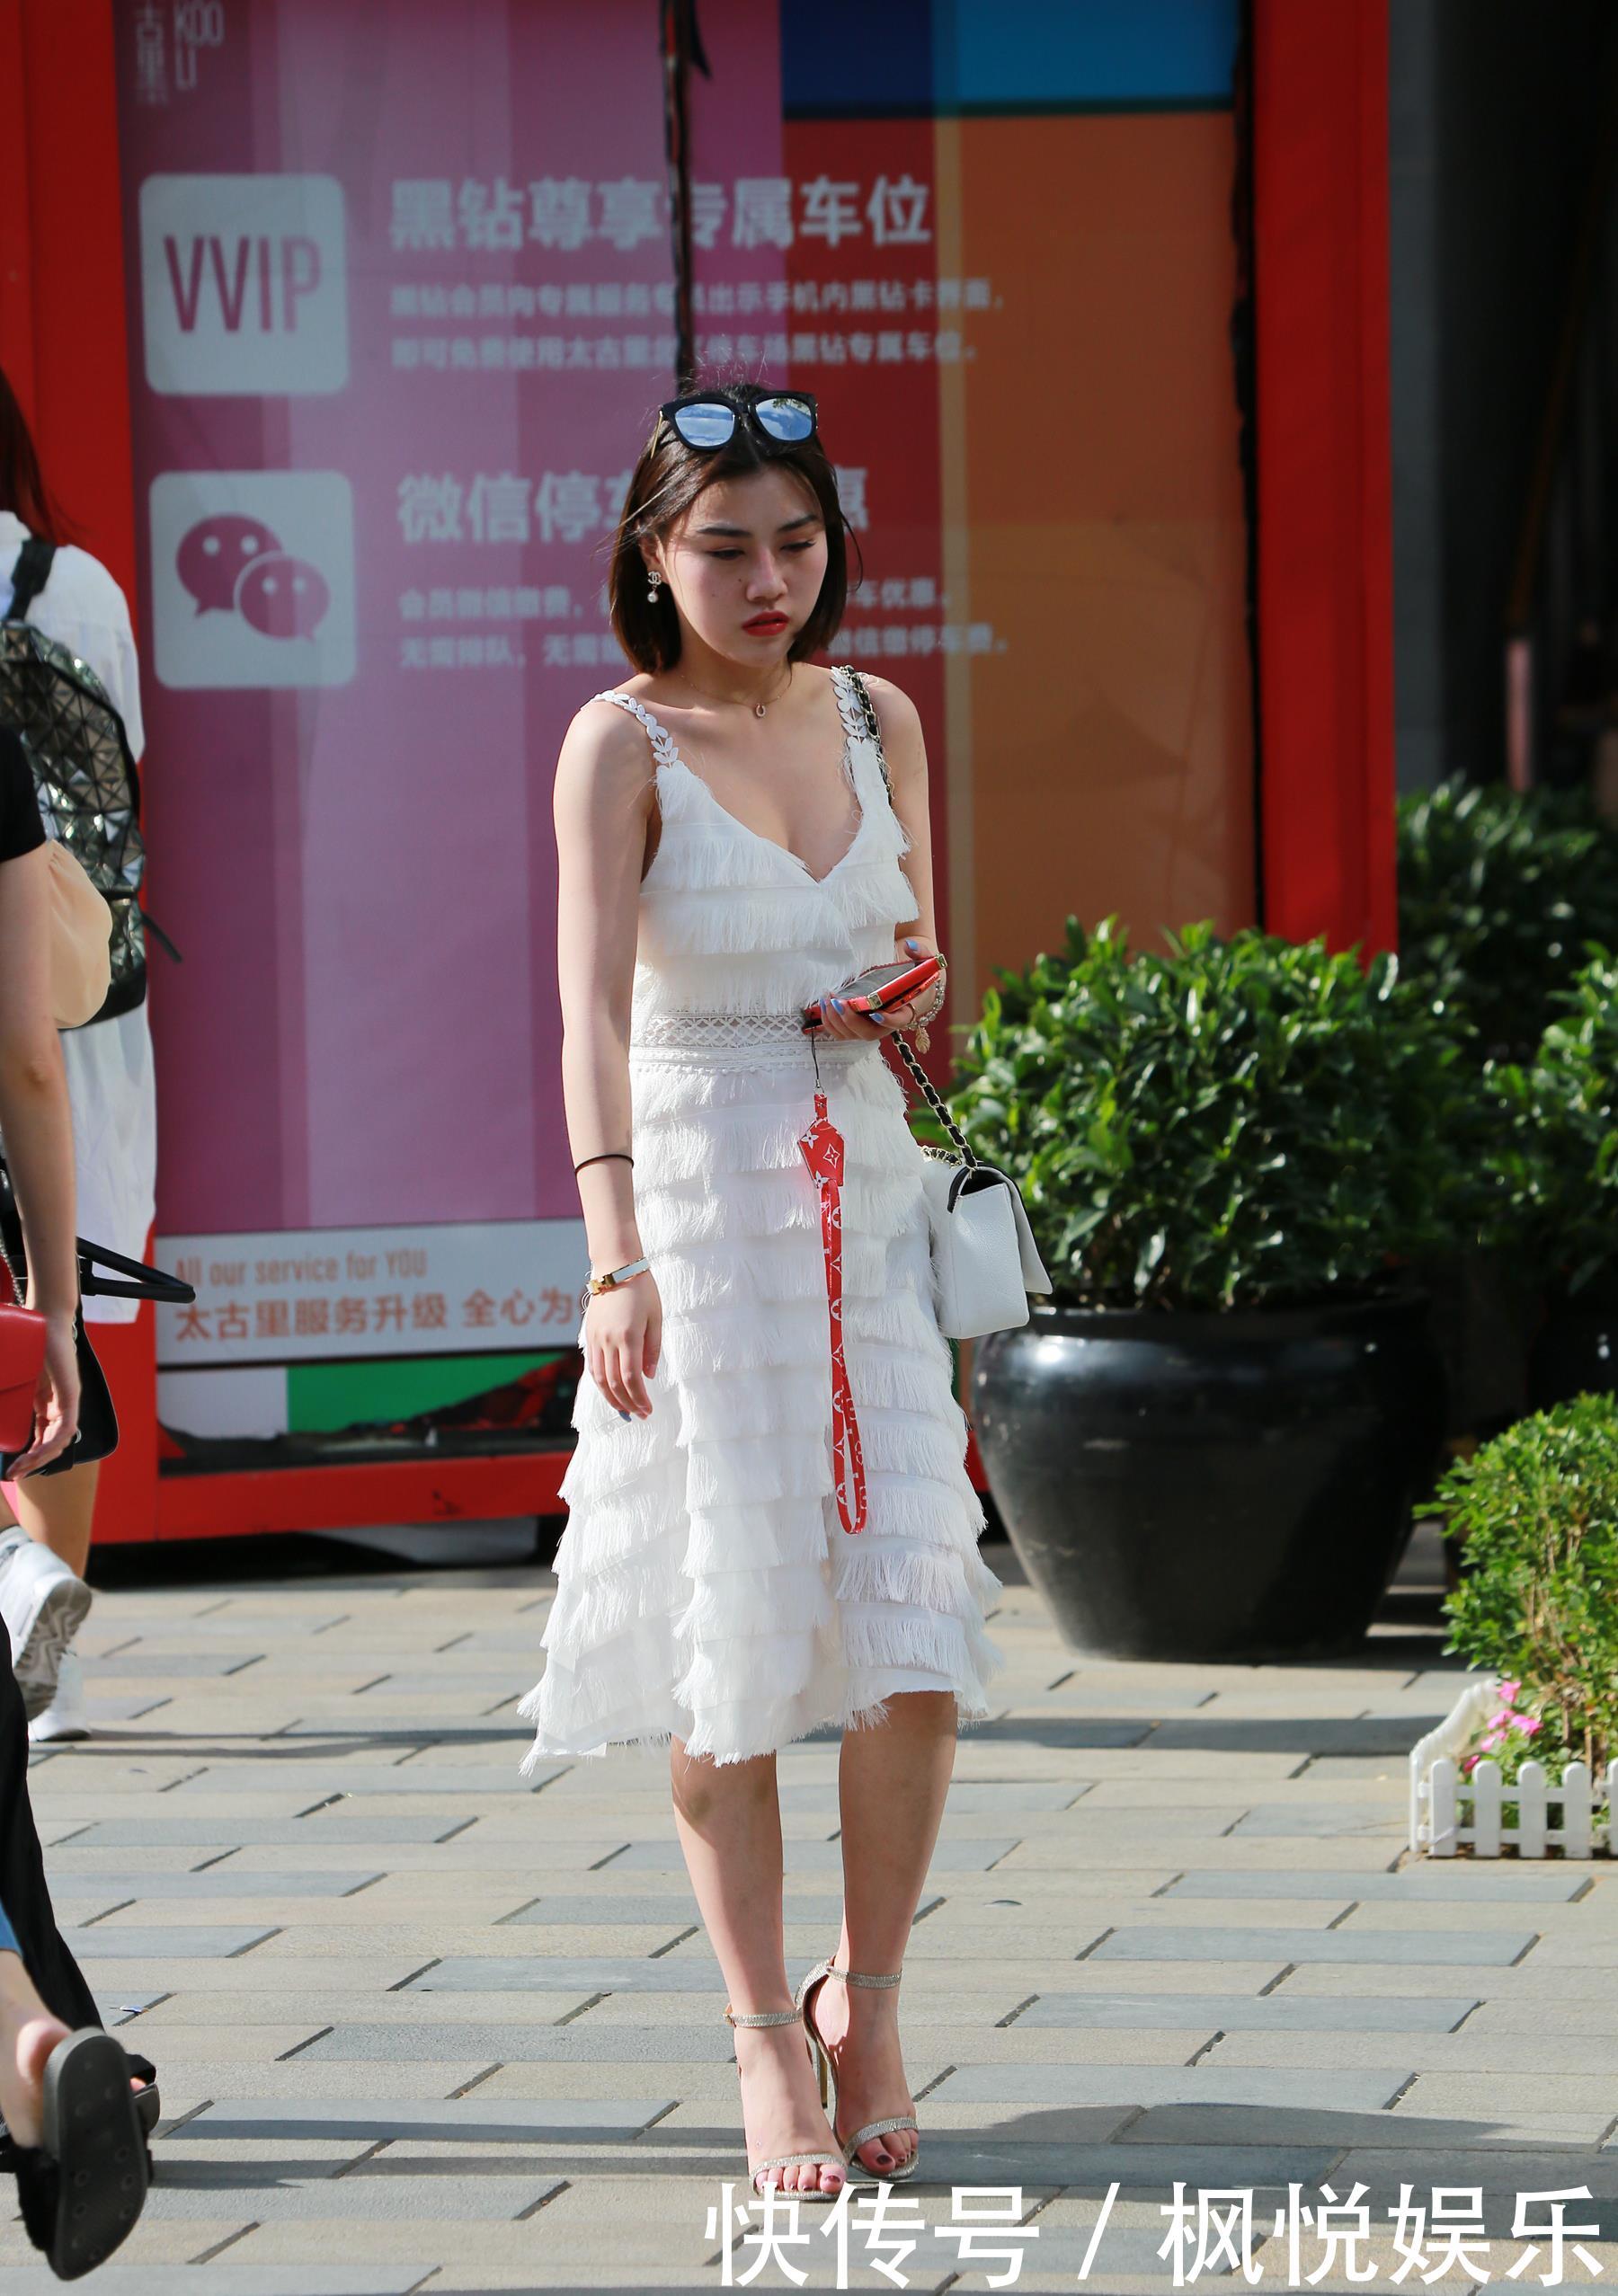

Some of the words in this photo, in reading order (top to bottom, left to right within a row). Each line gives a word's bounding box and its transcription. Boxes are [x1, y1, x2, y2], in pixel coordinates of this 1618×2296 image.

[390, 174, 931, 251] 黑钻尊享专属车位
[164, 235, 322, 333] VVIP
[209, 1262, 247, 1287] our
[254, 1251, 339, 1285] service
[346, 1247, 378, 1281] for
[384, 1246, 429, 1279] YOU
[175, 1290, 449, 1343] 太古里服务升级
